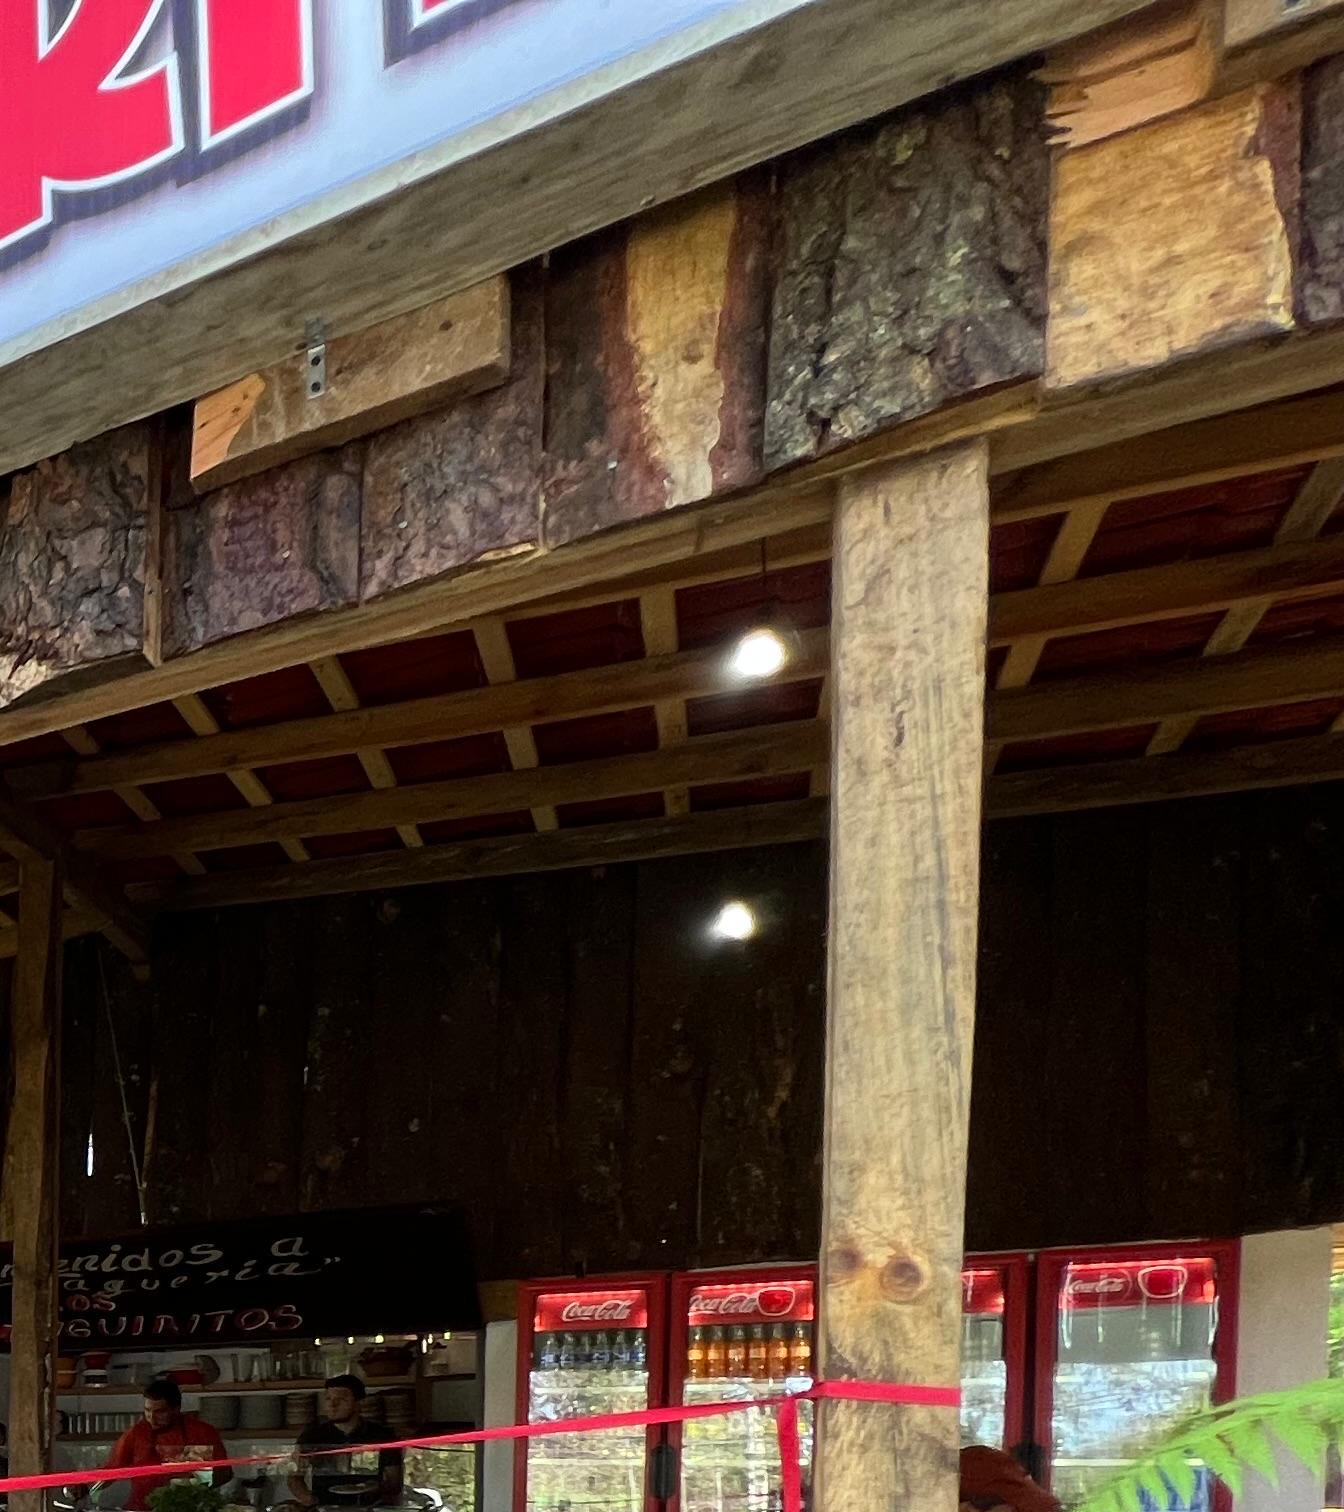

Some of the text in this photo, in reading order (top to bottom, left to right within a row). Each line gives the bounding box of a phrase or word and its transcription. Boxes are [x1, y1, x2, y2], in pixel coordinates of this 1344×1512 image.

[270, 1236, 311, 1258] a
[59, 1291, 117, 1313] OS
[562, 1299, 631, 1322] Coca-Cola
